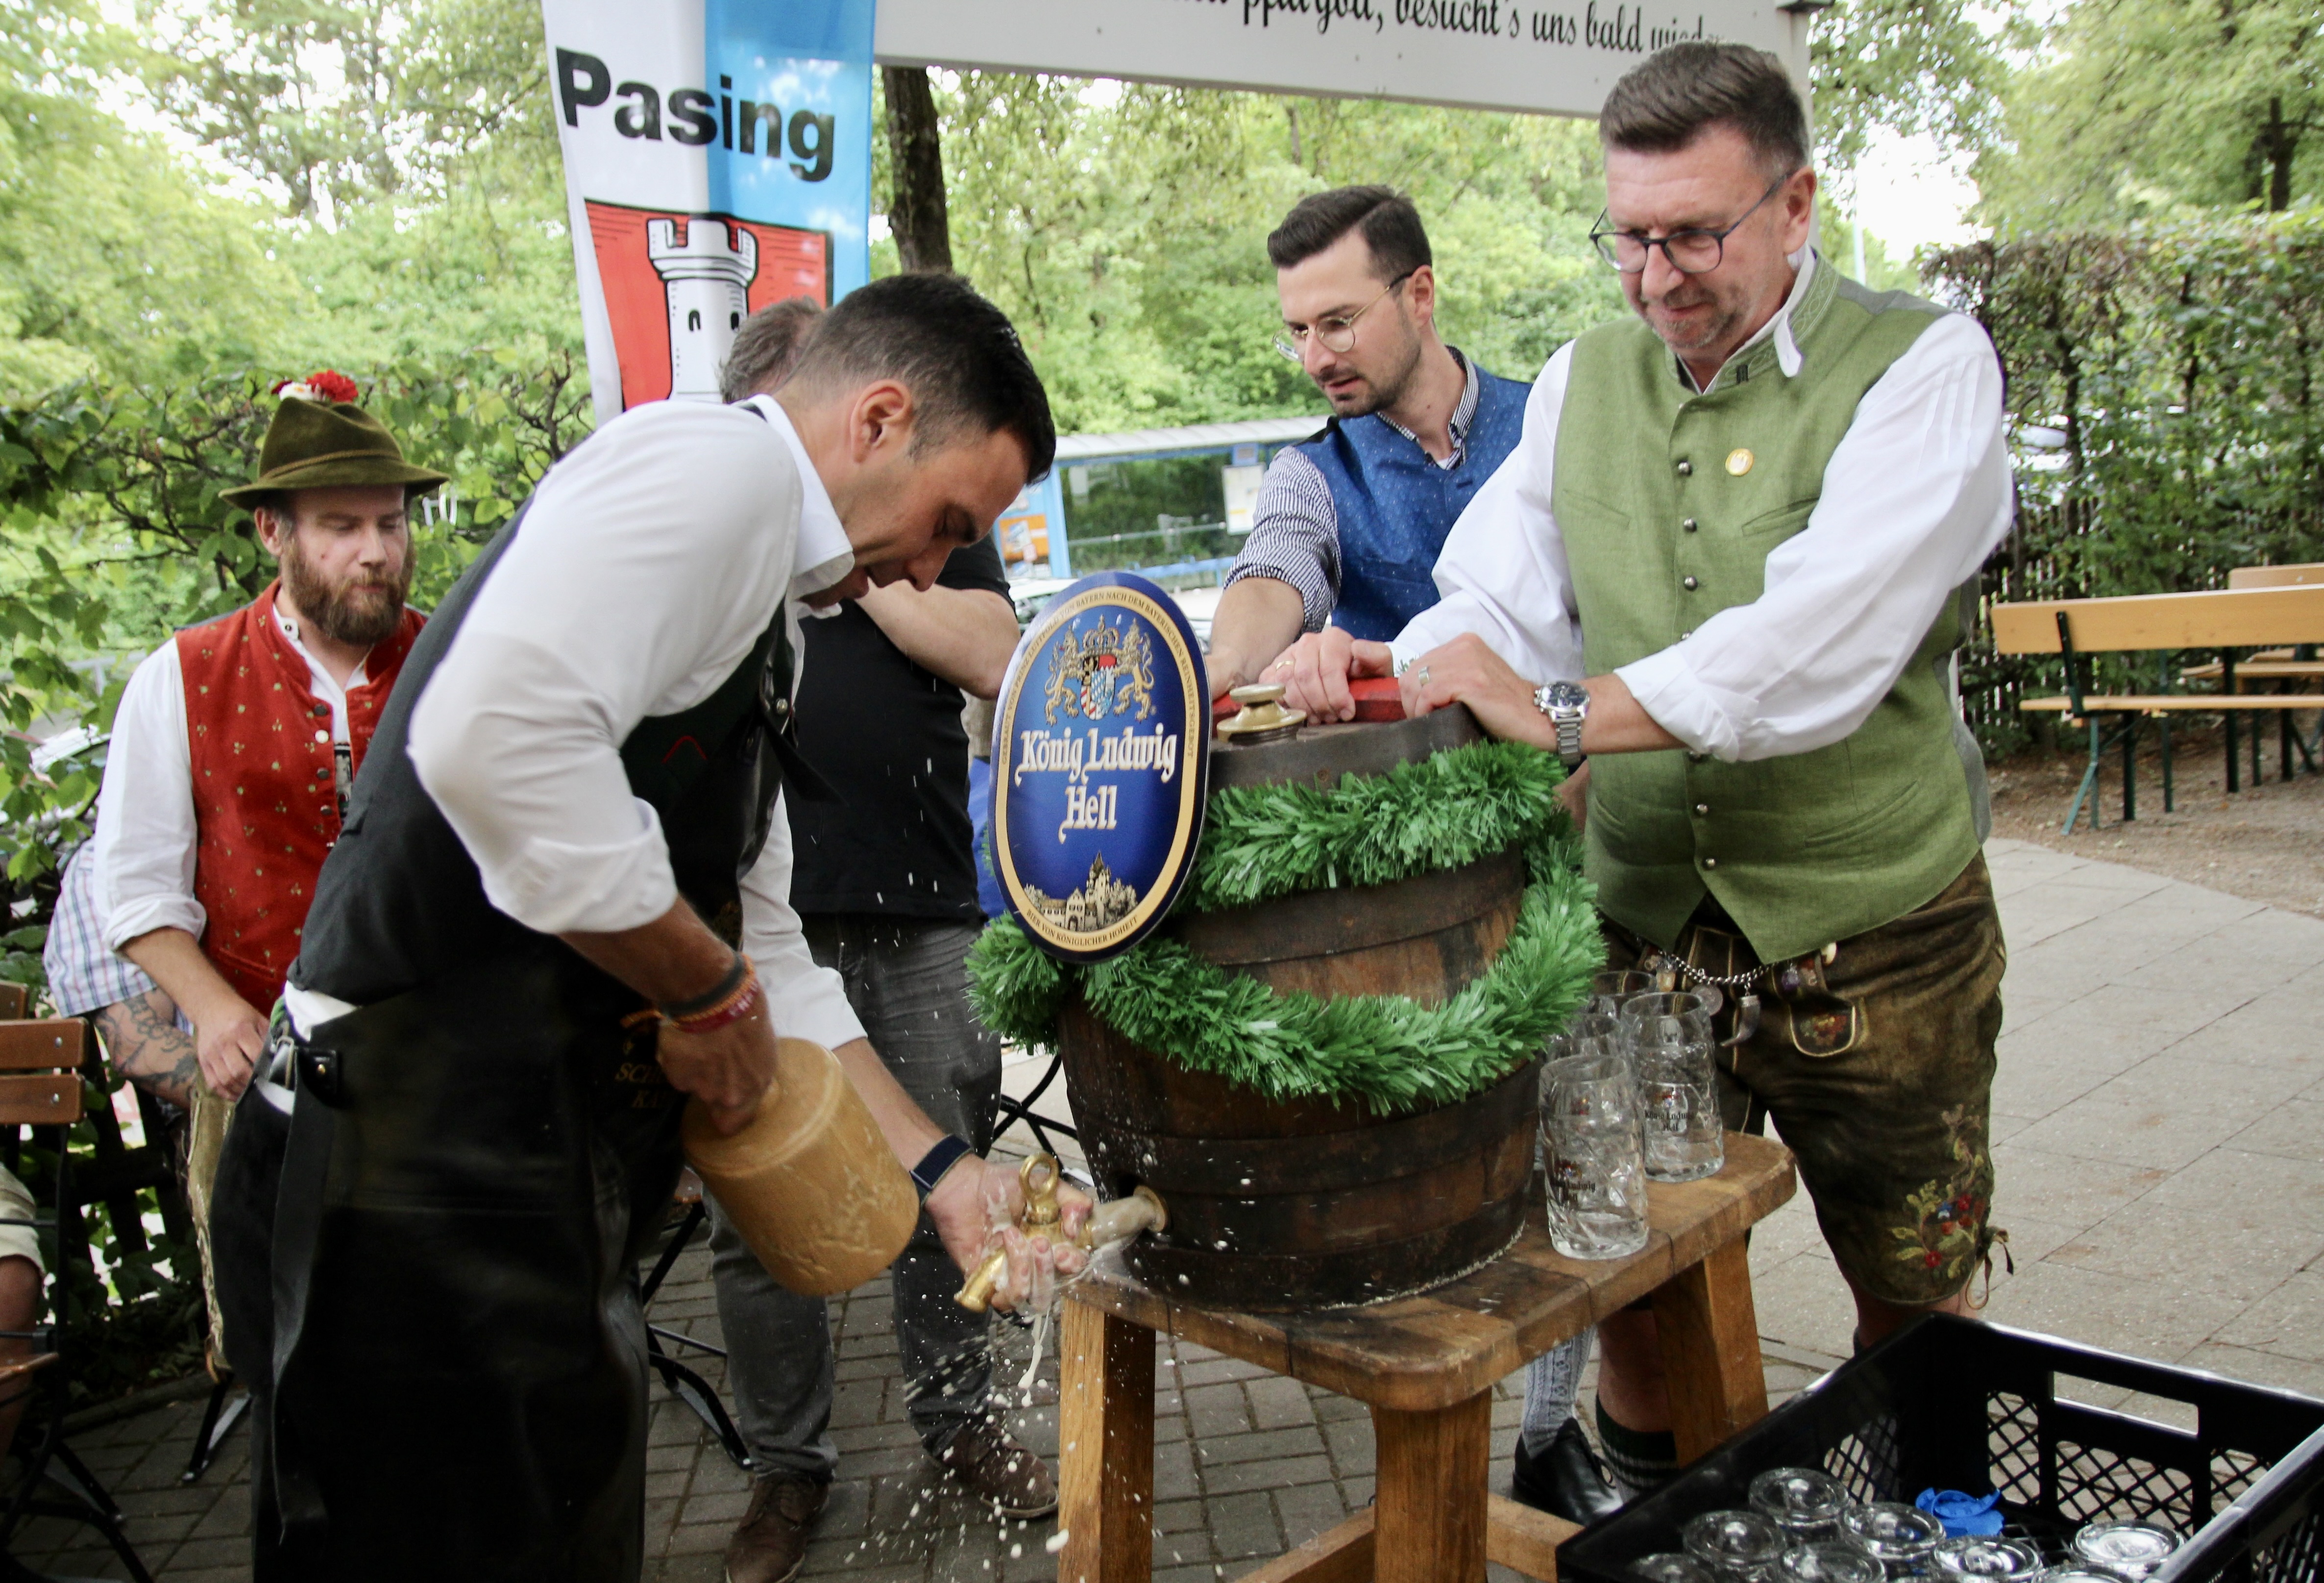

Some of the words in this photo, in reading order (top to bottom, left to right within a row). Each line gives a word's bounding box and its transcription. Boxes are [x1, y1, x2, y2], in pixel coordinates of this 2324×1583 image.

[1533, 11, 1576, 45] uns
[1586, 0, 1642, 53] bald
[556, 47, 834, 182] Pasing
[1008, 690, 1017, 710] VON
[1076, 592, 1104, 607] BAYERN
[1106, 592, 1127, 600] NACH
[1127, 595, 1145, 609] DEM
[1145, 603, 1183, 657] BAYERISCHEN
[1180, 657, 1196, 759] REINHEITSGEBOT
[1014, 726, 1084, 787] König
[1081, 722, 1177, 784] Ludwig
[1058, 785, 1118, 844] Hell
[1027, 910, 1040, 928] BIER
[1042, 923, 1054, 937] VON
[1056, 932, 1107, 946] KÖNIGLICHER
[1110, 914, 1138, 940] HOHEIT
